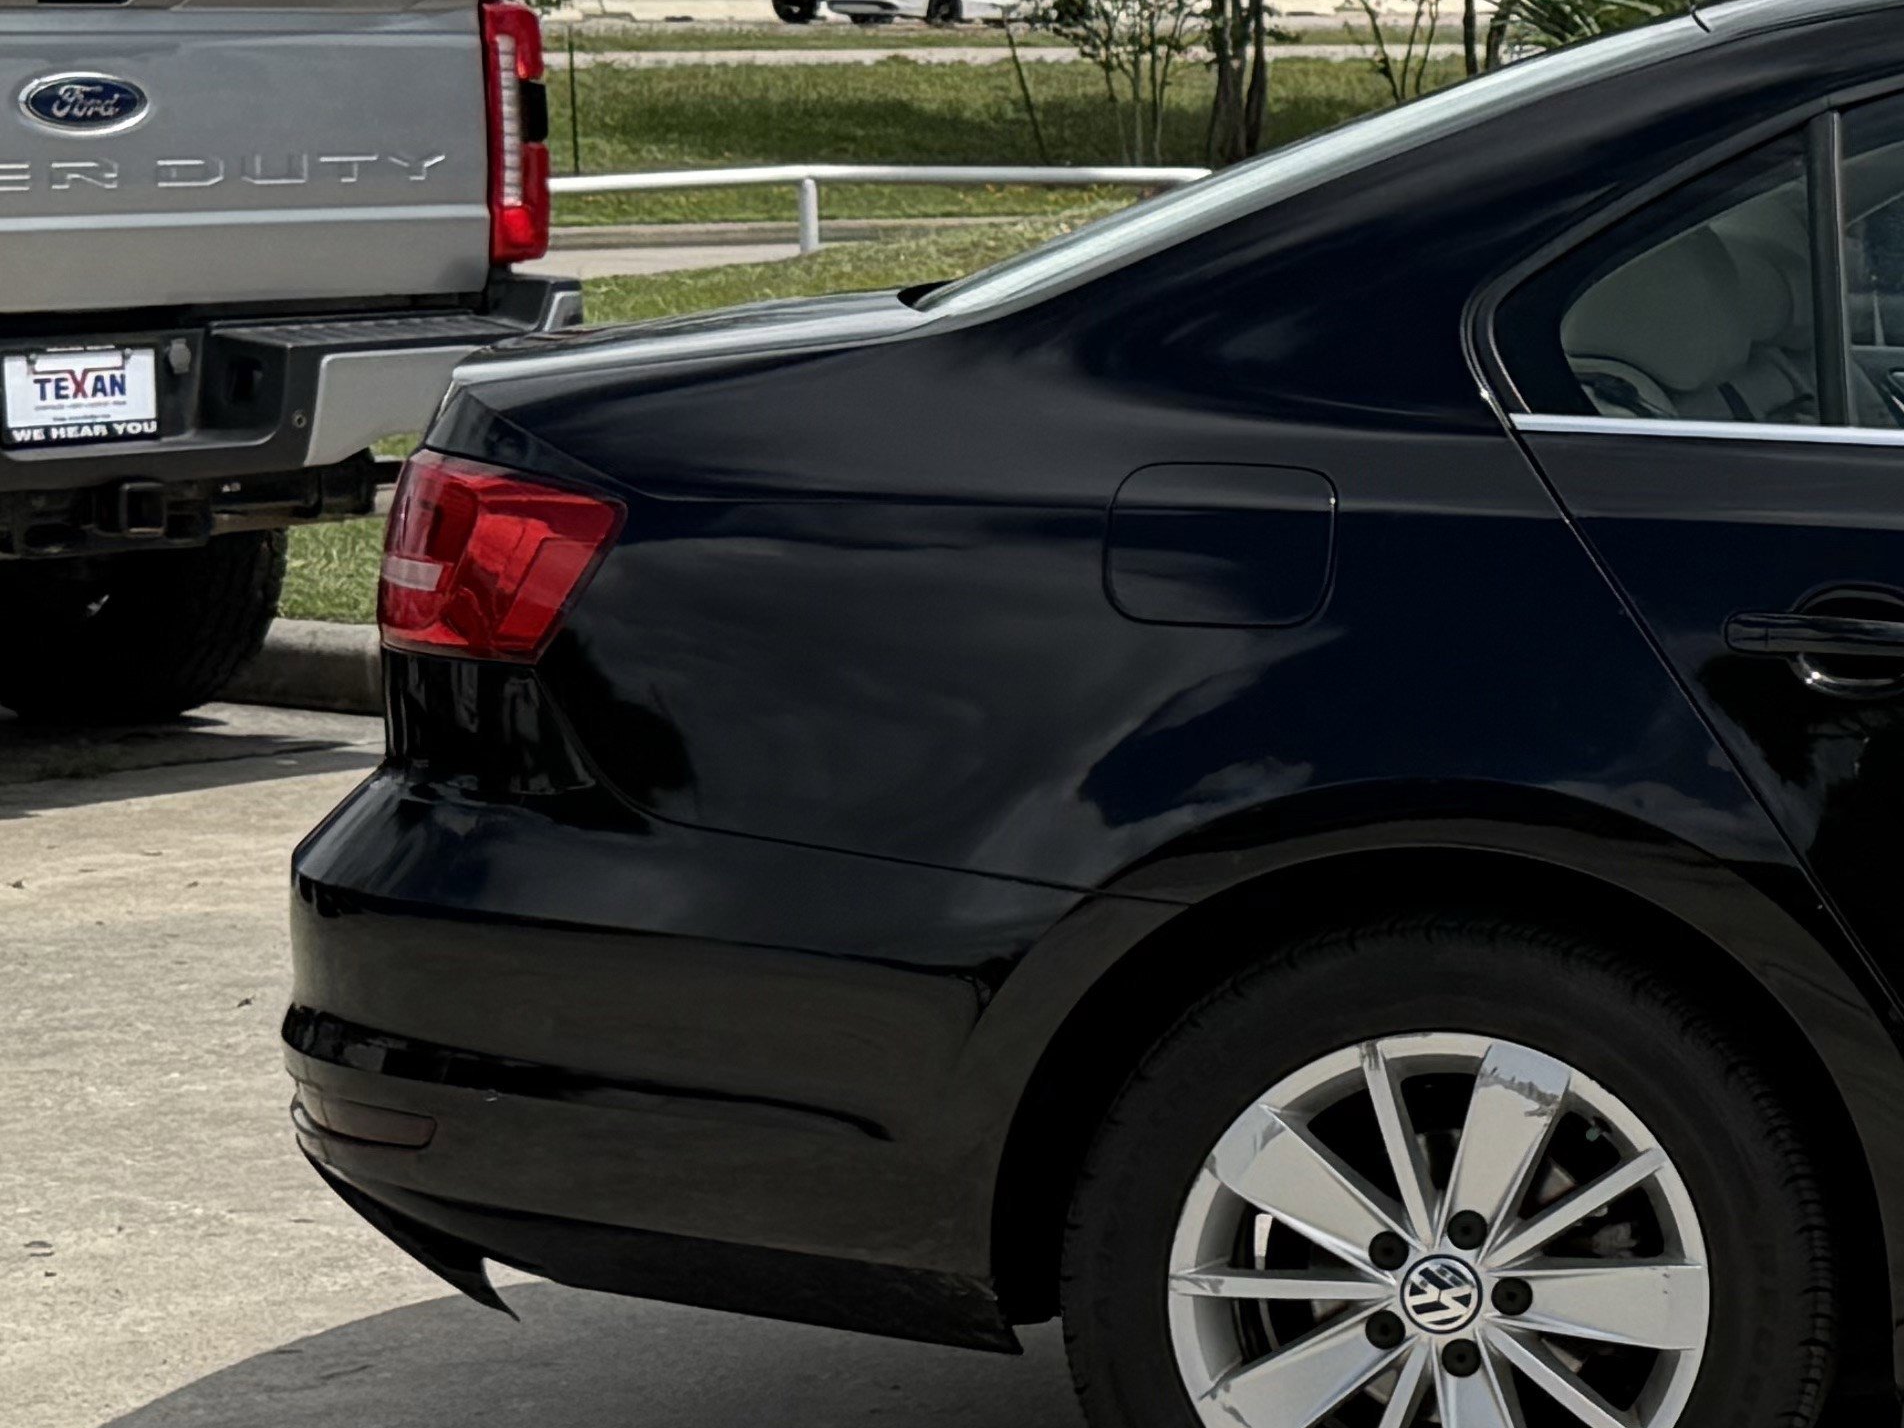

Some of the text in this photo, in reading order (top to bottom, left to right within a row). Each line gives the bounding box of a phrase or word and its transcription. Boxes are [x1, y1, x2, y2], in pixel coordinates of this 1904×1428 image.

[51, 84, 120, 118] Ford
[156, 154, 446, 188] DUTY
[33, 369, 127, 402] TEXAN
[11, 420, 158, 443] WE HEAR YOU
